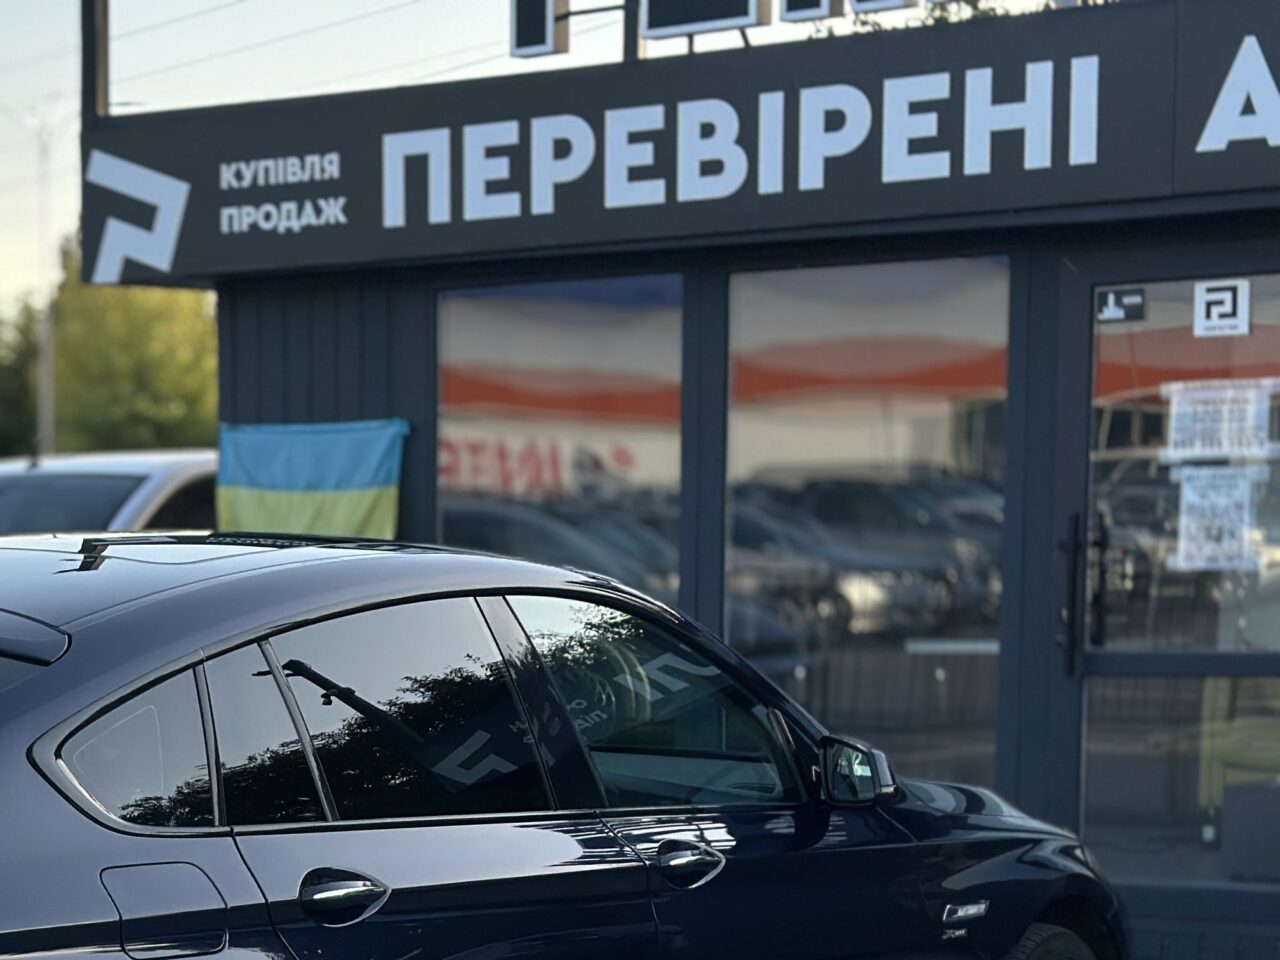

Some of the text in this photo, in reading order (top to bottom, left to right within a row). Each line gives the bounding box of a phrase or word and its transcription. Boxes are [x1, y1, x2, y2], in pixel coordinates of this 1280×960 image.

[382, 55, 1100, 228] ПЕРЕВІРЕНІ
[220, 151, 340, 190] КУПІВЛЯ
[220, 196, 347, 234] ПРОДАЖ
